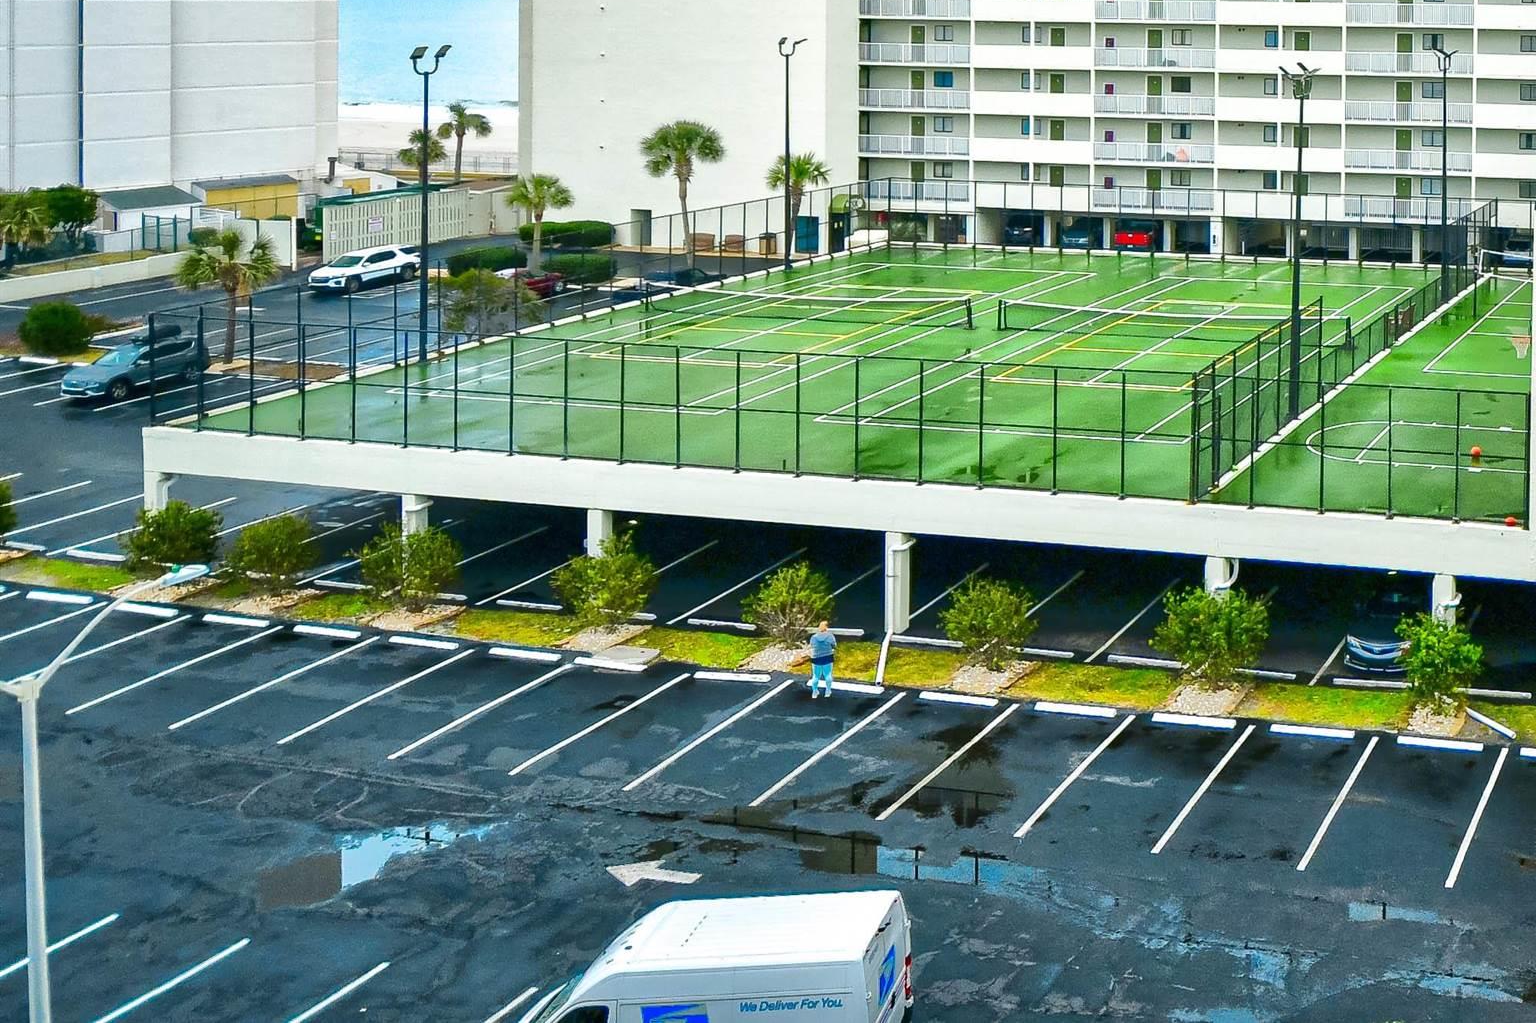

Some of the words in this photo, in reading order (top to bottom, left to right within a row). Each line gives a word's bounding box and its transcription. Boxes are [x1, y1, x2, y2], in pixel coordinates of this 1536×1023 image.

[740, 1001, 757, 1012] We
[759, 1000, 799, 1011] Deliver
[800, 998, 820, 1009] For
